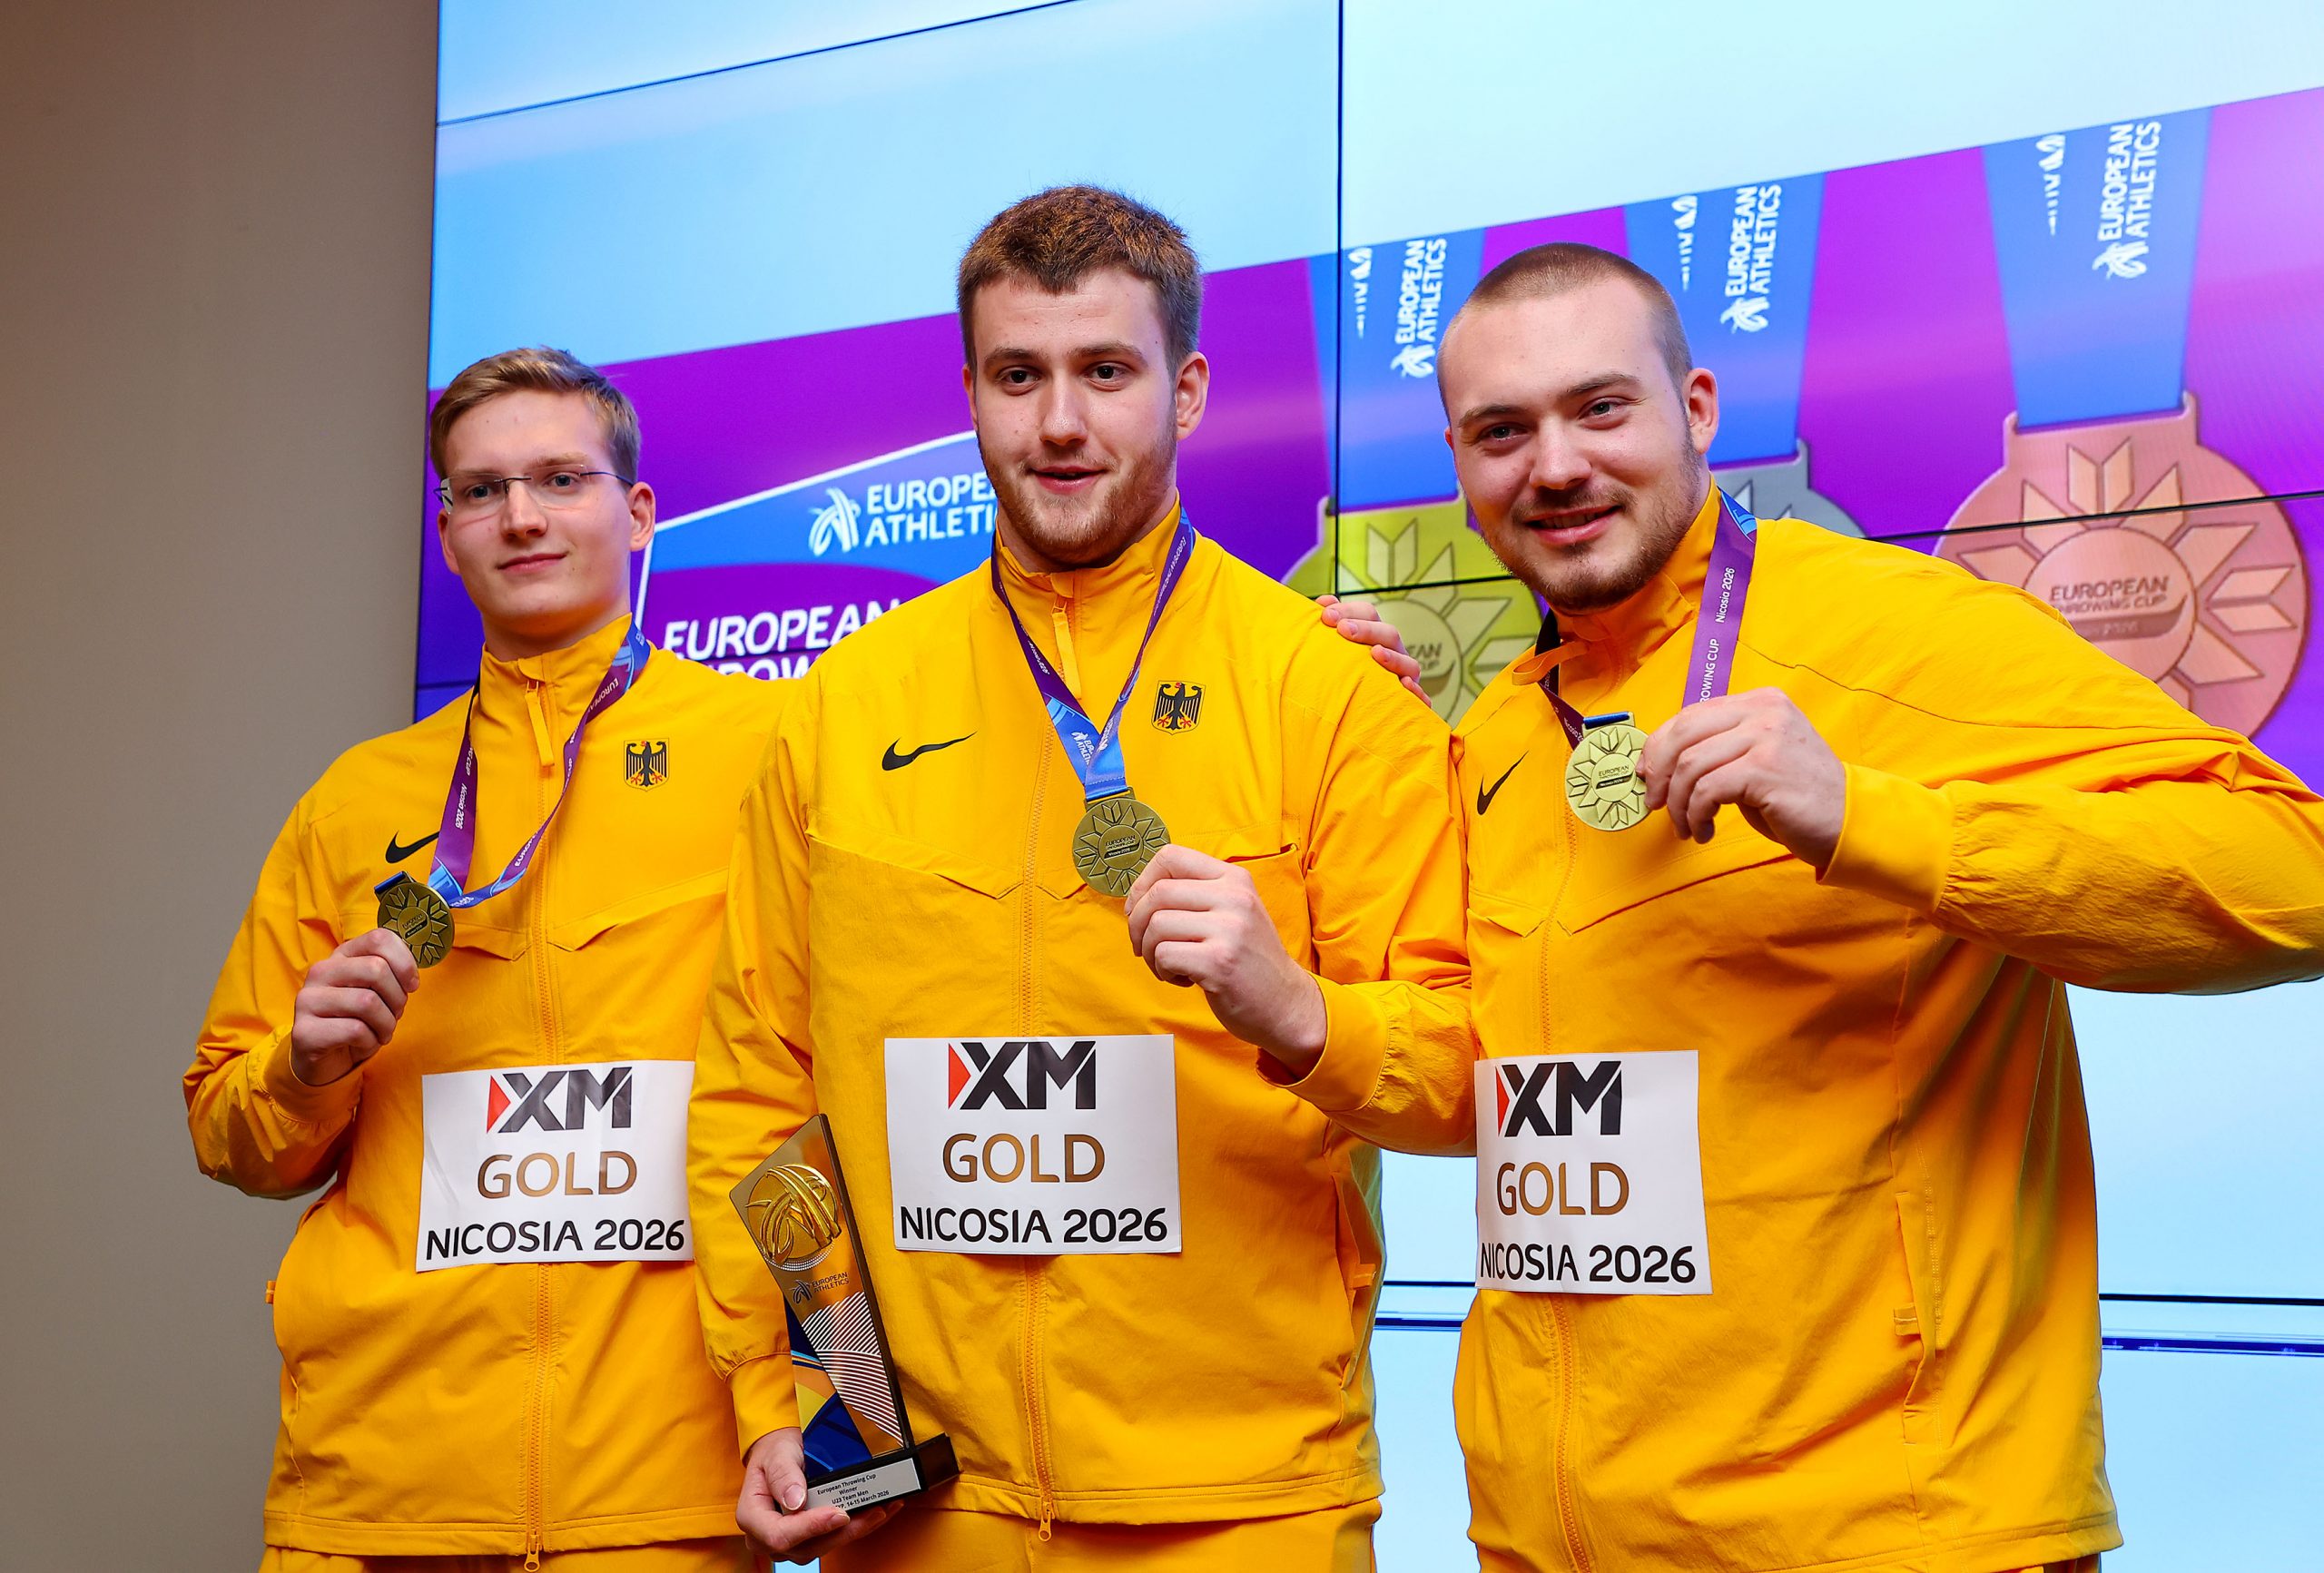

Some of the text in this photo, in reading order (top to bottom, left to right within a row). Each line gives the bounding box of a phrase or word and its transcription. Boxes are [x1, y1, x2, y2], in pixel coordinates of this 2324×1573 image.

[2097, 123, 2133, 241] EUROPEAN
[2125, 121, 2162, 238] ATHLETICS
[1725, 186, 1758, 297] EUROPEAN
[1748, 184, 1782, 294] ATHLETICS
[1394, 240, 1425, 344] EUROPEAN
[1416, 239, 1447, 342] ATHLETICS
[864, 503, 998, 548] ATHLETI
[1721, 566, 1736, 592] 2026
[2050, 576, 2170, 601] EUROPEAN
[1715, 590, 1729, 624] Nicosia
[1709, 638, 1720, 662] CUP
[588, 677, 620, 712] EUROPEA
[1599, 765, 1630, 777] EUROPEAN
[458, 783, 468, 810] Nicosia
[455, 808, 465, 830] 2026
[949, 1041, 1096, 1110] XM
[487, 1067, 632, 1134] XM
[1496, 1060, 1622, 1137] XM
[478, 1150, 637, 1199] GOLD
[943, 1133, 1106, 1183] GOLD
[1497, 1162, 1630, 1215] GOLD
[426, 1219, 684, 1260] NICOSIA 2026
[901, 1206, 1167, 1243] NICOSIA 2026
[812, 1272, 848, 1287] EUROPEAN
[1481, 1243, 1696, 1283] NICOSIA 2026
[814, 1278, 850, 1293] ATHLETICS
[817, 1473, 876, 1495] European Throwing Cup
[839, 1486, 858, 1495] Winner
[842, 1493, 857, 1501] Team
[847, 1498, 861, 1507] 14-15
[861, 1492, 877, 1503] March
[878, 1489, 889, 1499] 2026
